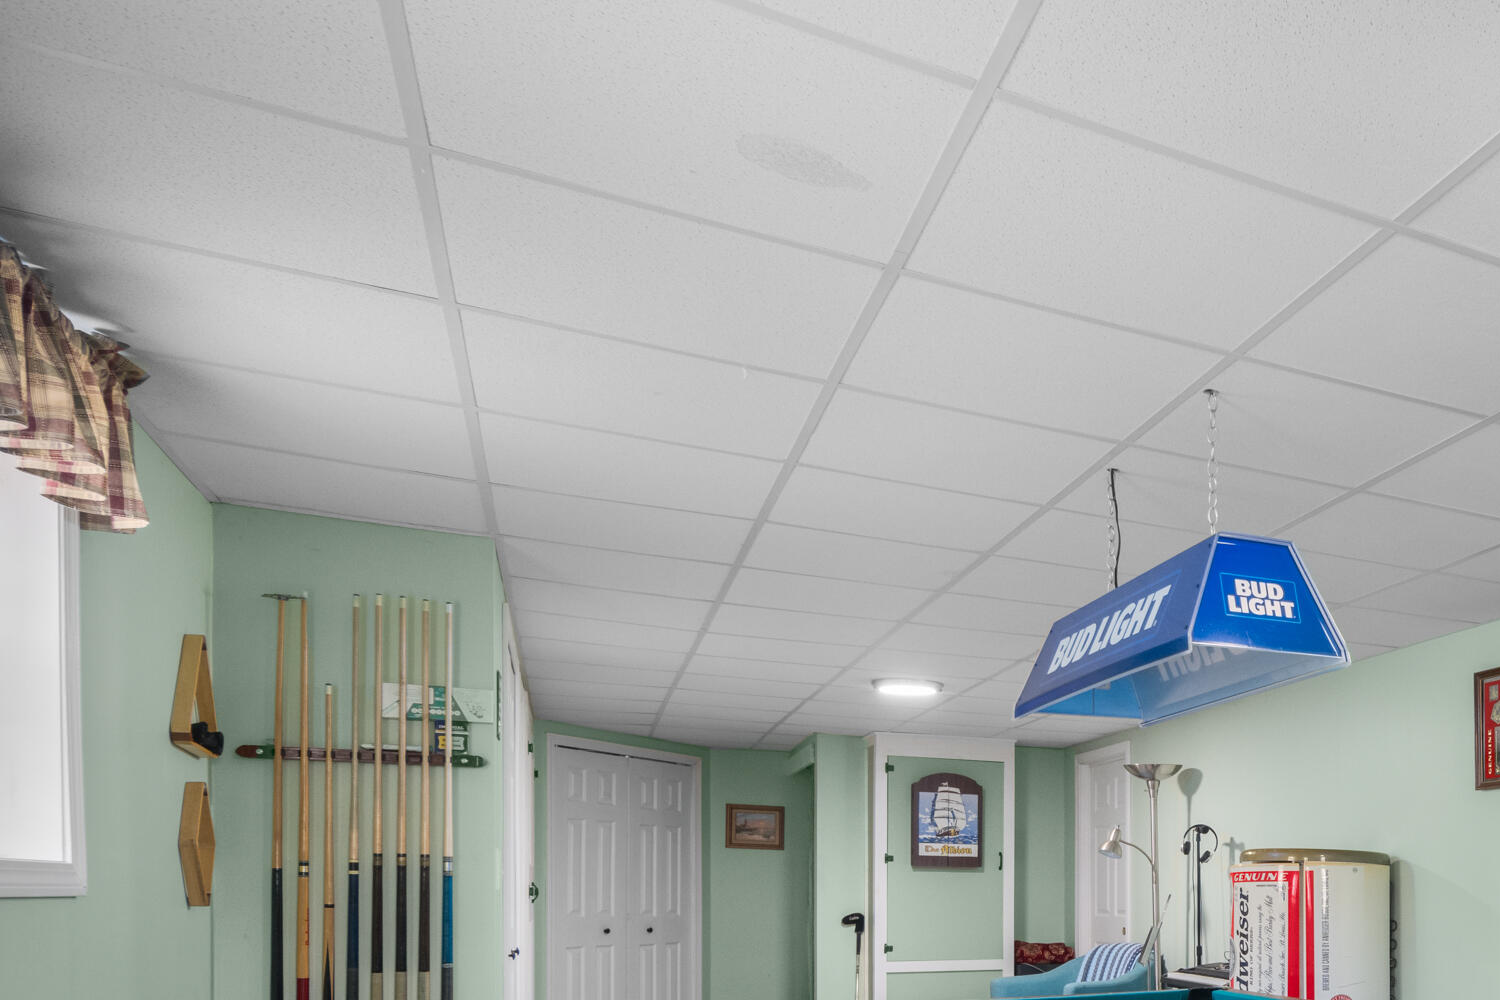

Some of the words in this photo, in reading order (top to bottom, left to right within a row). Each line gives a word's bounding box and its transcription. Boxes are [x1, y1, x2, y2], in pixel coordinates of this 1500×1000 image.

[1234, 578, 1284, 600] BUD
[1227, 594, 1295, 619] LIGHT
[1047, 626, 1099, 675] BUD
[1089, 584, 1172, 655] LIGHT
[1233, 872, 1289, 882] GENUINE
[1236, 888, 1249, 991] dweiser
